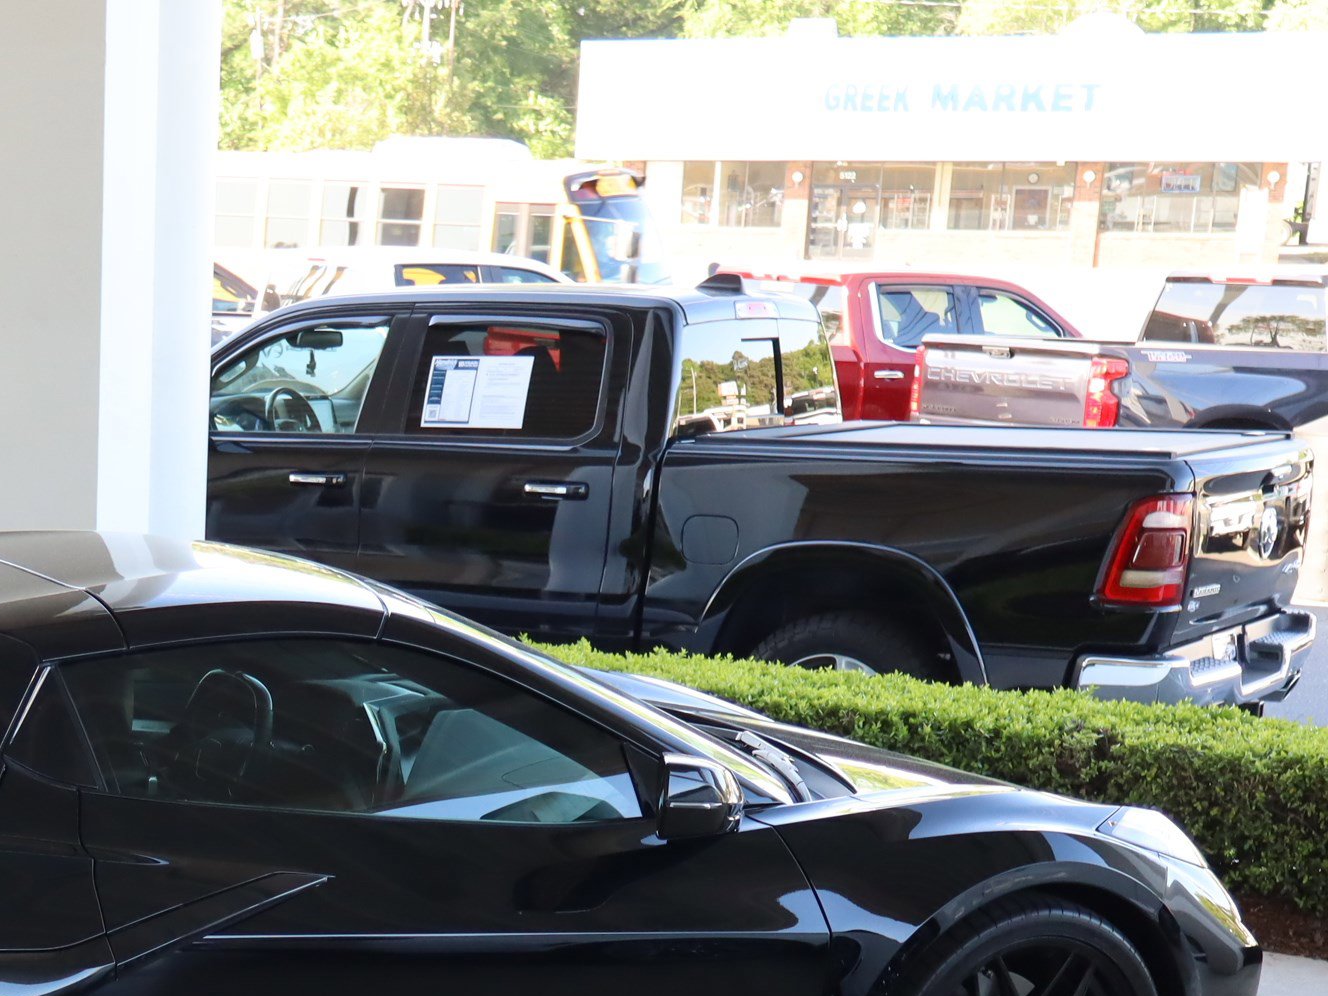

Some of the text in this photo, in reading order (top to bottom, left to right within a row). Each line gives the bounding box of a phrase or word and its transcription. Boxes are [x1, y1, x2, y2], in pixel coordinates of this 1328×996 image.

[824, 83, 1103, 112] GREEK MARKET
[927, 367, 1072, 391] CHEVROLET
